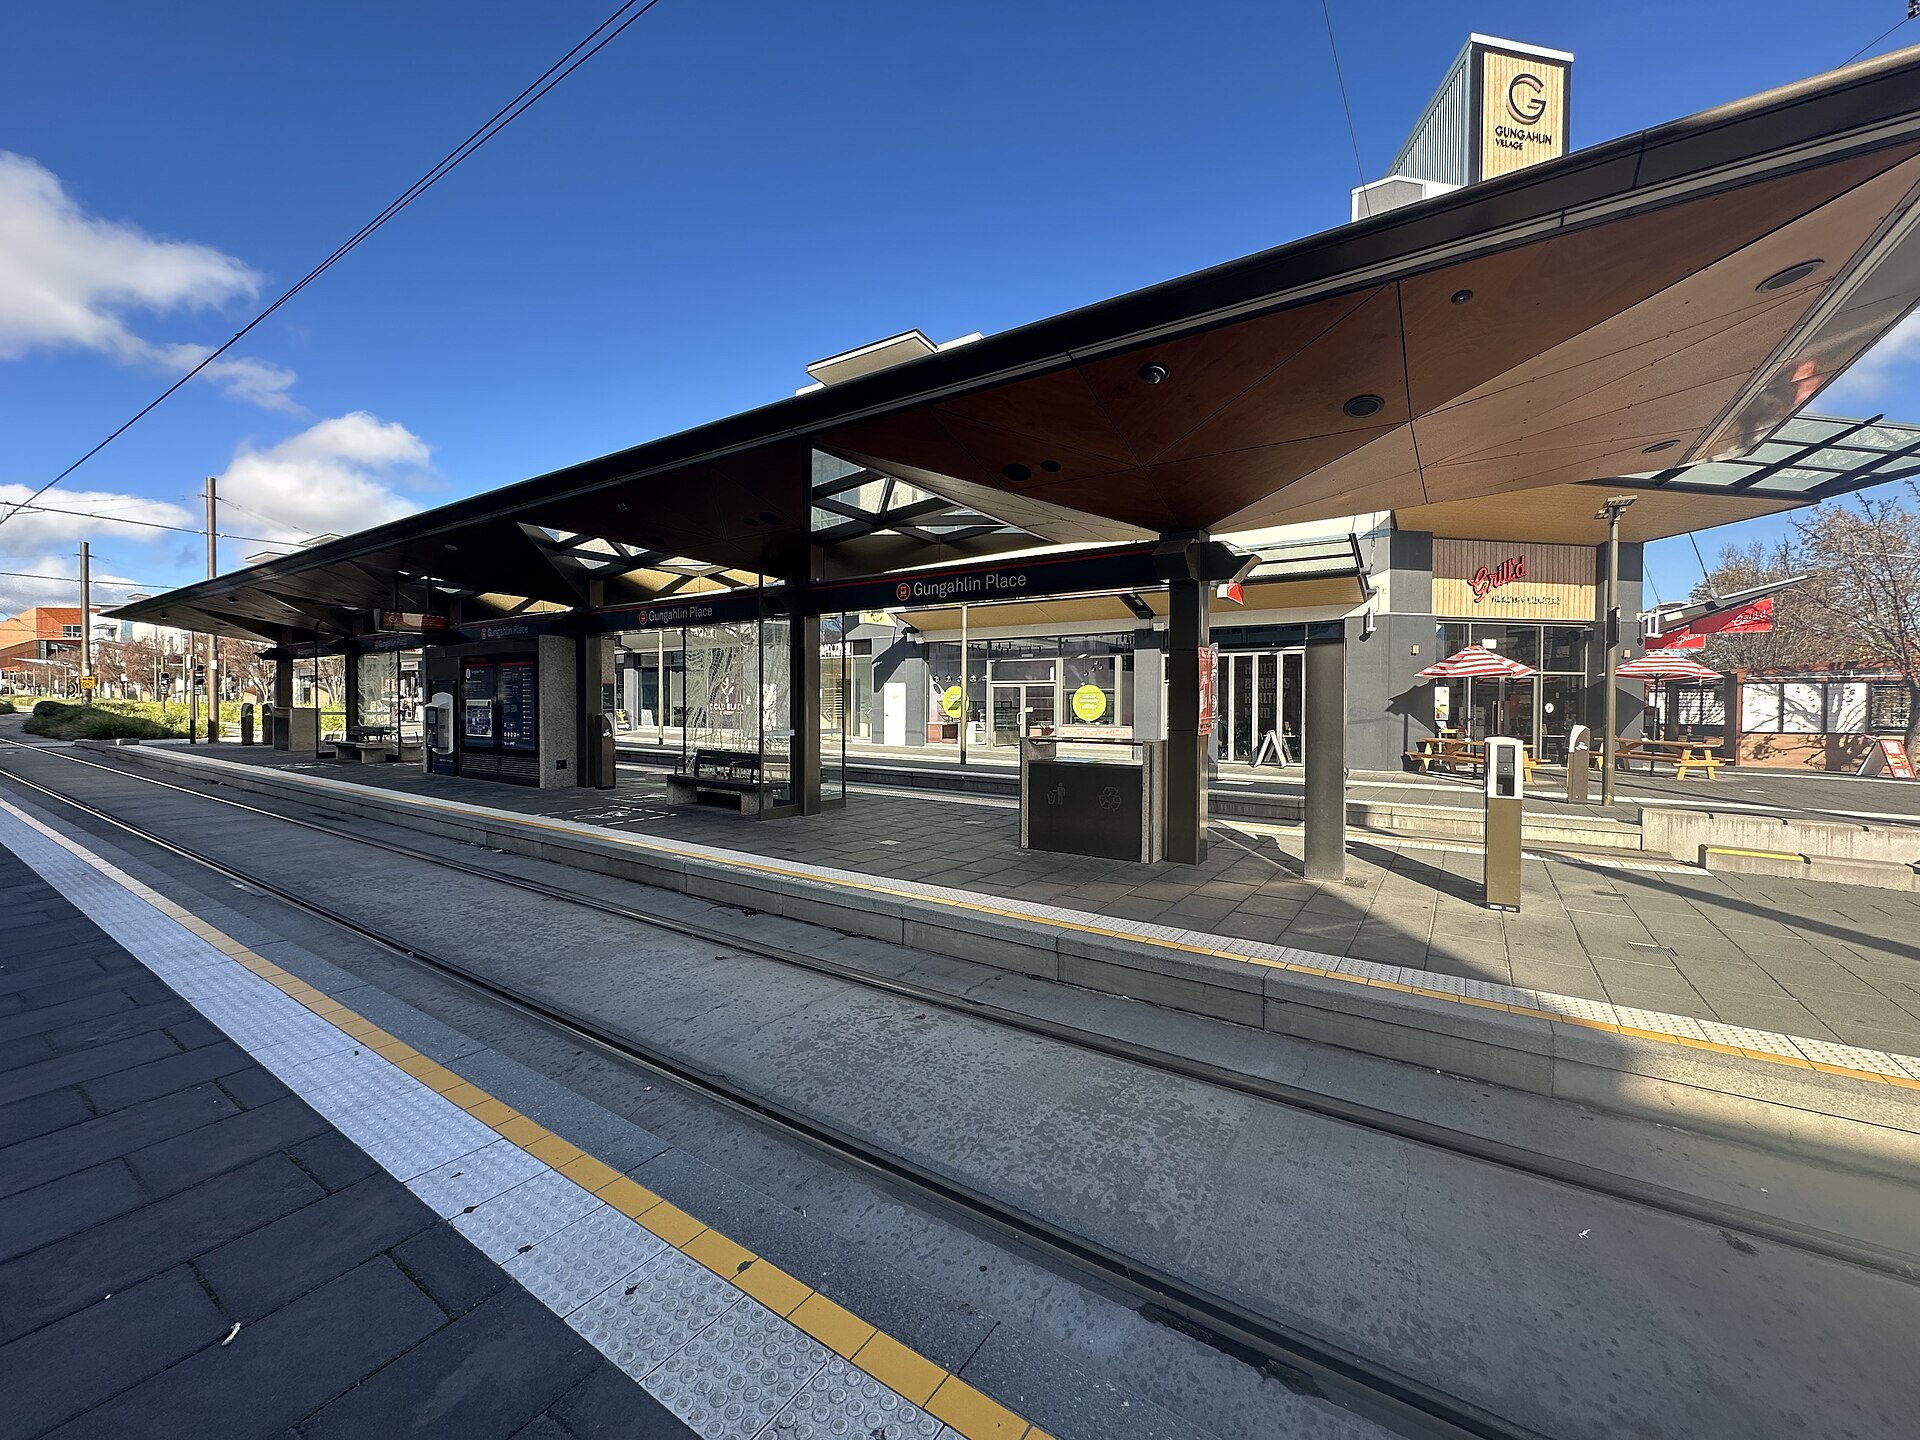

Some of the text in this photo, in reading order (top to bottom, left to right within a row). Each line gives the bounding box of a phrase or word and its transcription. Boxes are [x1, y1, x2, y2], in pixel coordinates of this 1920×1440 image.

[1506, 73, 1547, 124] G
[1495, 125, 1552, 145] GUNGAHLIN
[1495, 138, 1523, 151] VILLAGE
[913, 573, 1027, 598] Gungahlin Place
[1467, 554, 1528, 604] Grill'd
[648, 606, 713, 624] Gungahlin Place
[487, 625, 529, 639] Gungahlin Place
